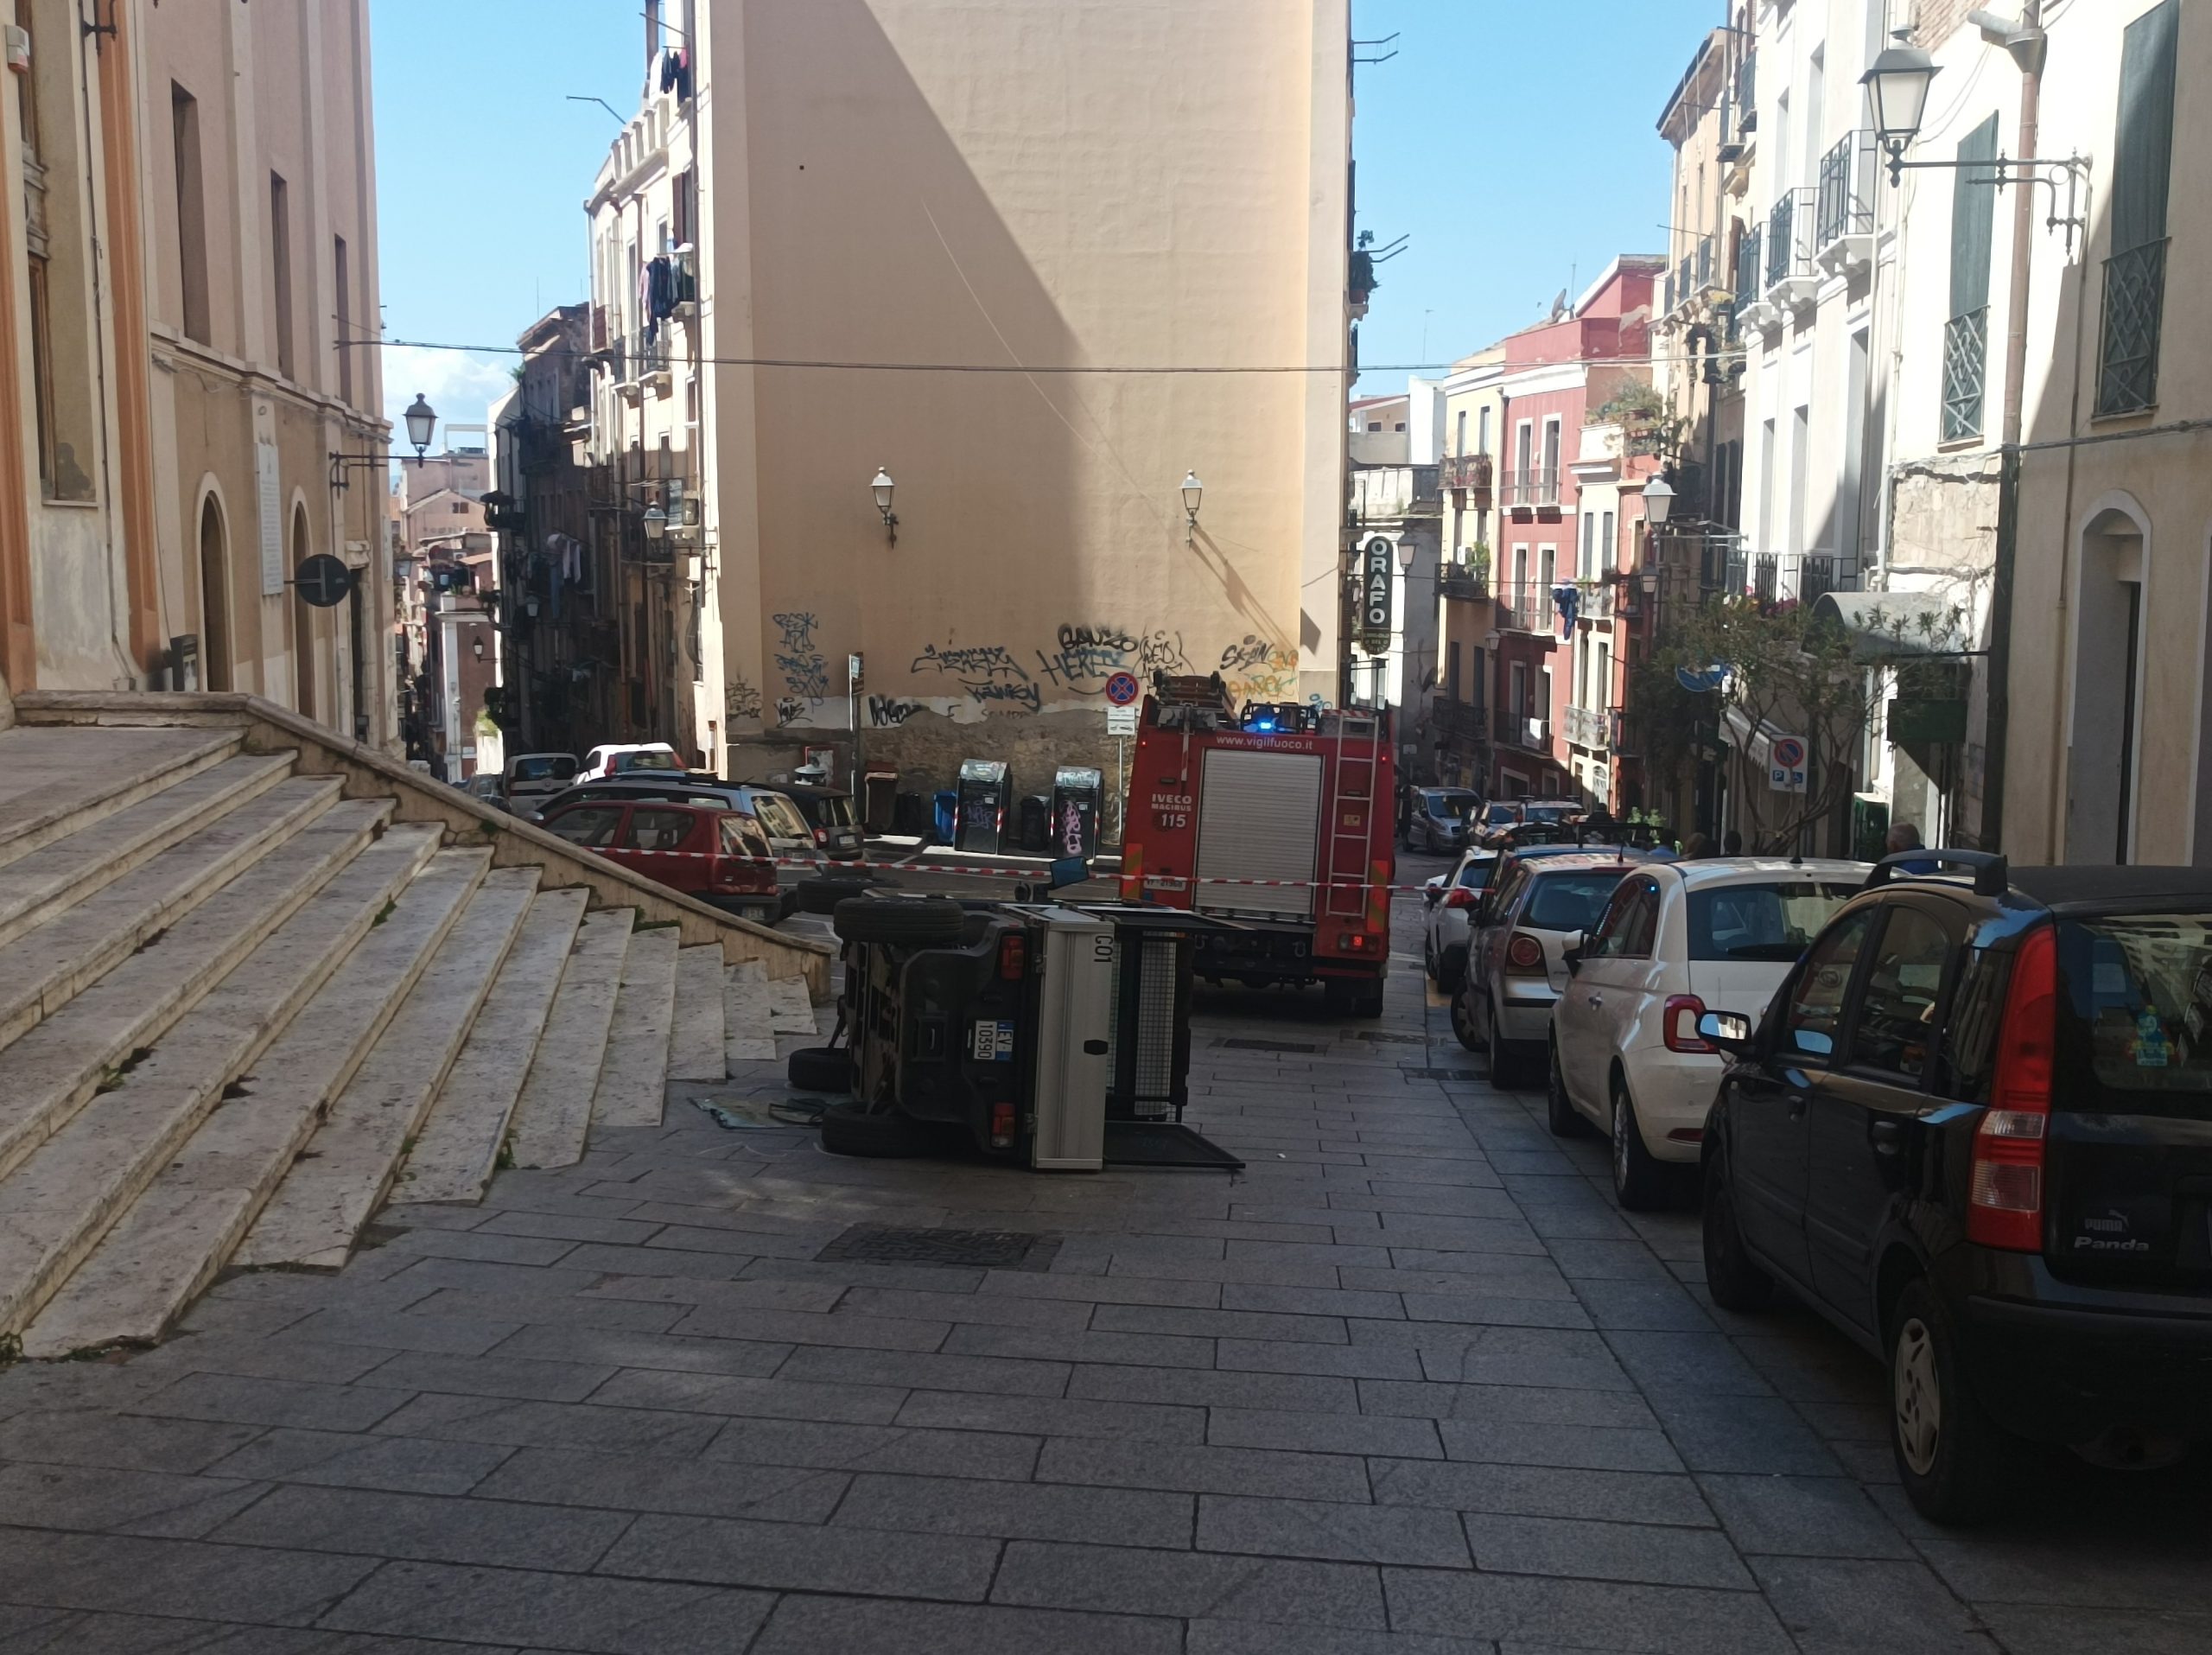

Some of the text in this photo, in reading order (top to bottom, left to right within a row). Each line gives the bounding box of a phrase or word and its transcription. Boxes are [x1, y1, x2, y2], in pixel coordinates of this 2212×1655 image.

[1370, 539, 1388, 624] ORAFO
[1216, 735, 1313, 750] www.vigilfuoco.it
[1152, 793, 1192, 804] IVECO
[1151, 803, 1192, 812] MAGIRUS
[1161, 813, 1186, 828] 115
[977, 1023, 995, 1060] 10390
[2084, 1218, 2123, 1232] PUMA
[2074, 1236, 2150, 1251] Panda
